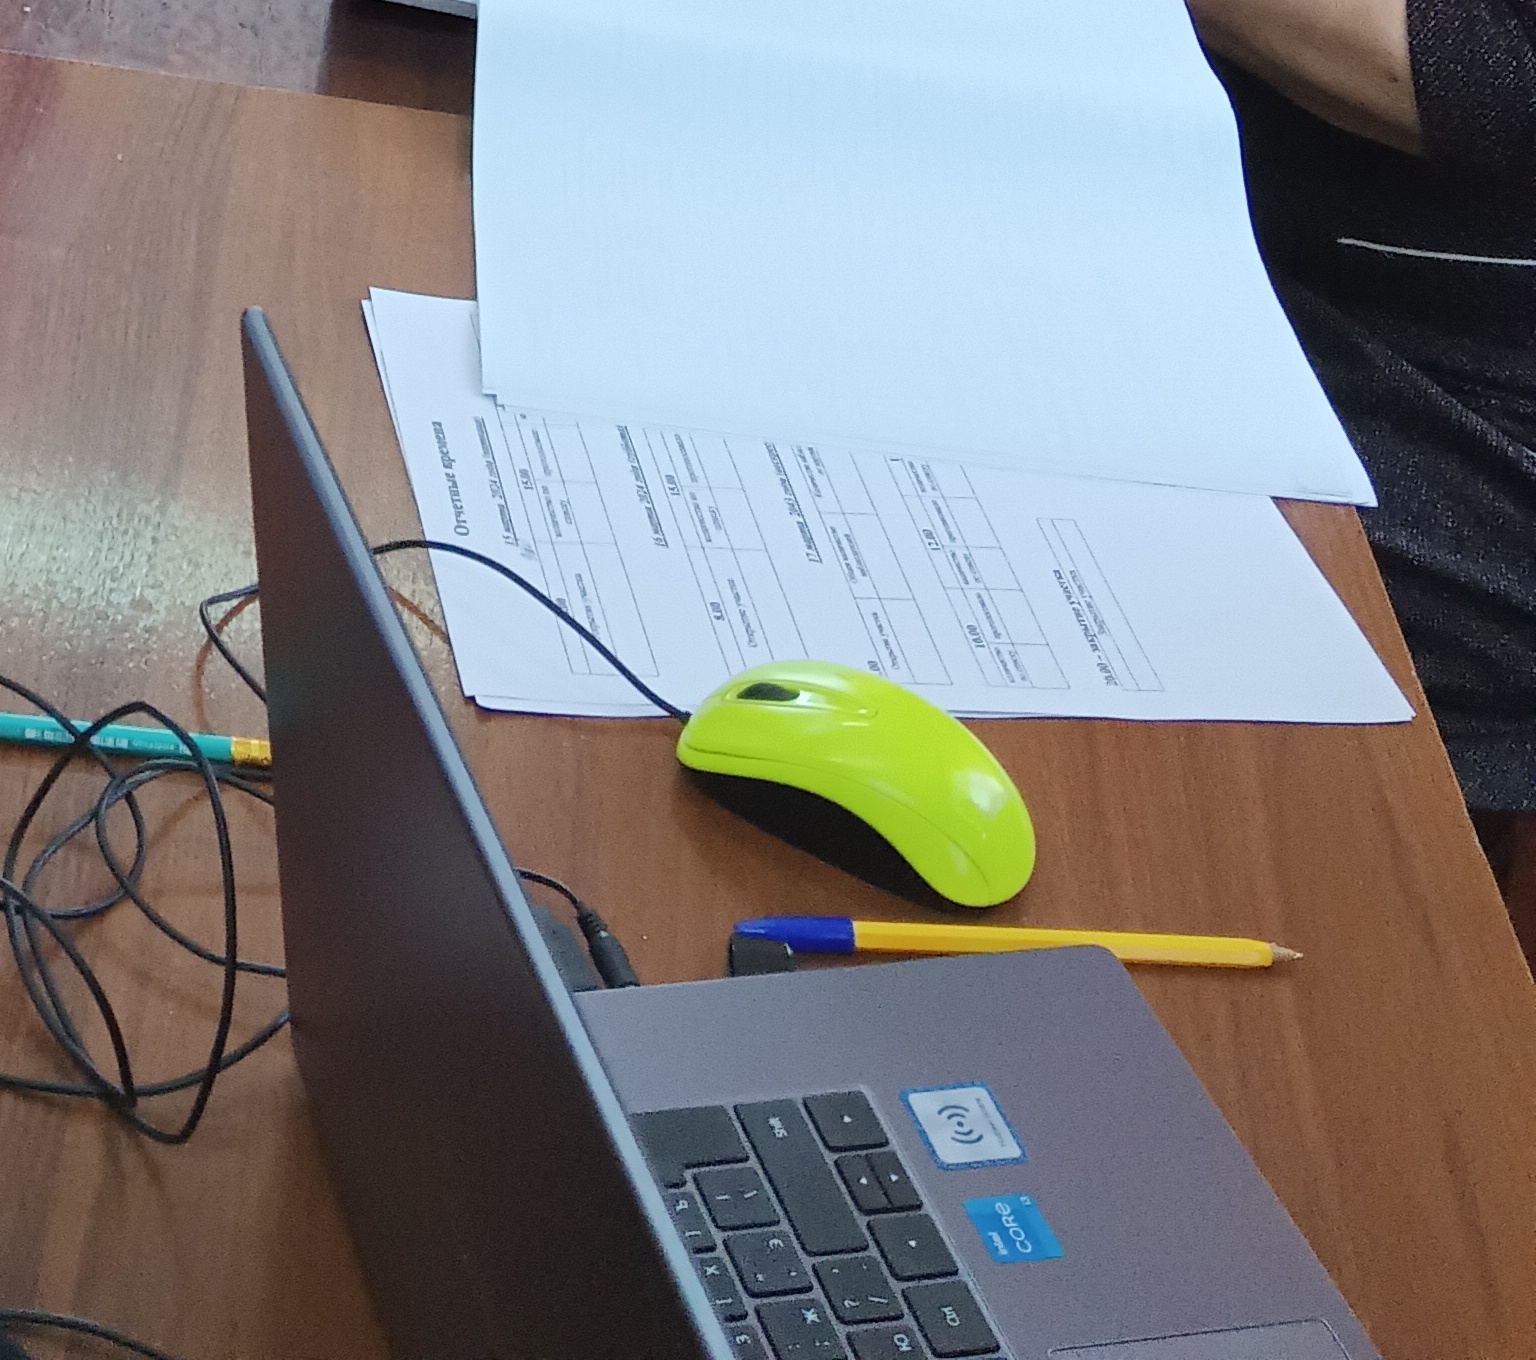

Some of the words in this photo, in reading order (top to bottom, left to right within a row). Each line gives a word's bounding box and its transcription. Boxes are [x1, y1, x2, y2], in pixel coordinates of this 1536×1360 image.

[767, 1116, 789, 1140] Shift
[987, 1231, 1009, 1257] intel
[800, 1308, 822, 1325] Ж
[941, 1306, 961, 1327] Ctrl
[893, 1333, 912, 1352] Ю
